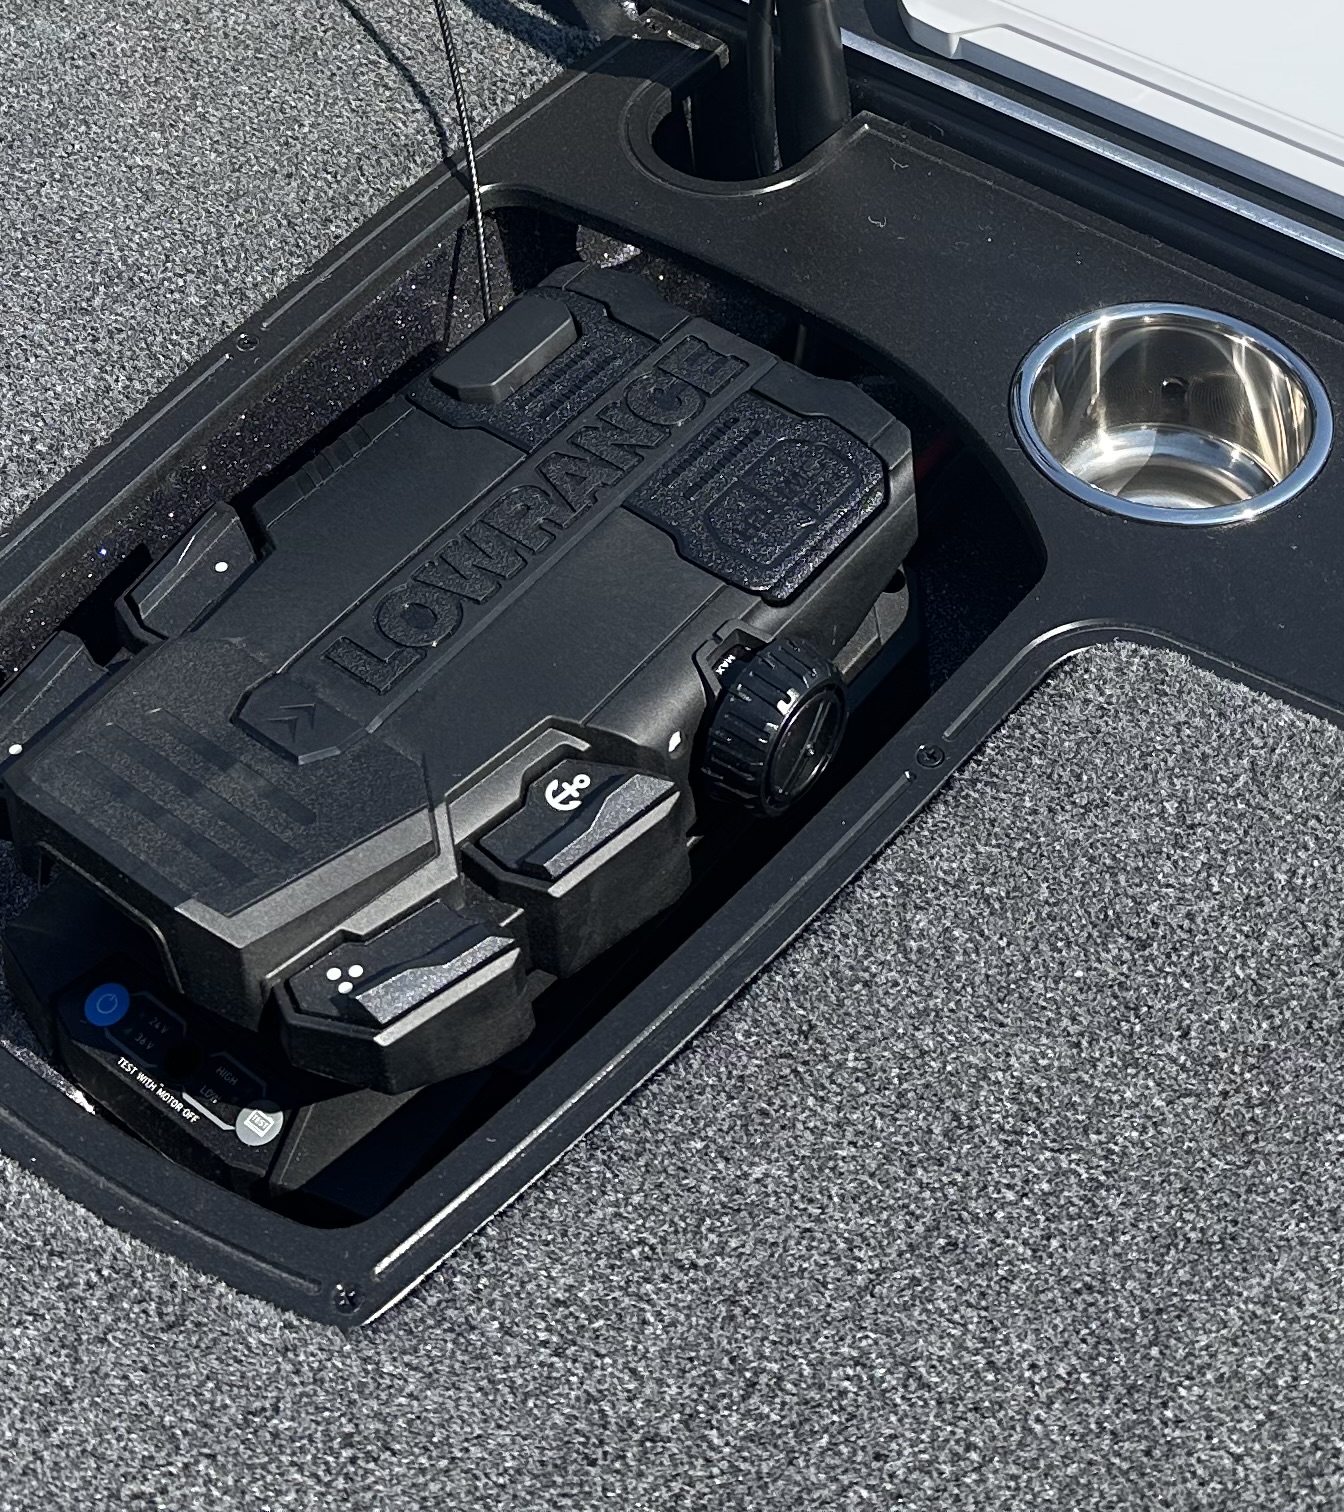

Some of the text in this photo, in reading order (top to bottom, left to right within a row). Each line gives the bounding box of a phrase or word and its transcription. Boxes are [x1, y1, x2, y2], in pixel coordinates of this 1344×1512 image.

[319, 334, 750, 695] LOWRANCE
[715, 654, 736, 675] MAX
[216, 1065, 239, 1086] HIGH
[117, 1056, 201, 1124] TEST WITH MOTOR OFF
[250, 1113, 270, 1130] TEST
